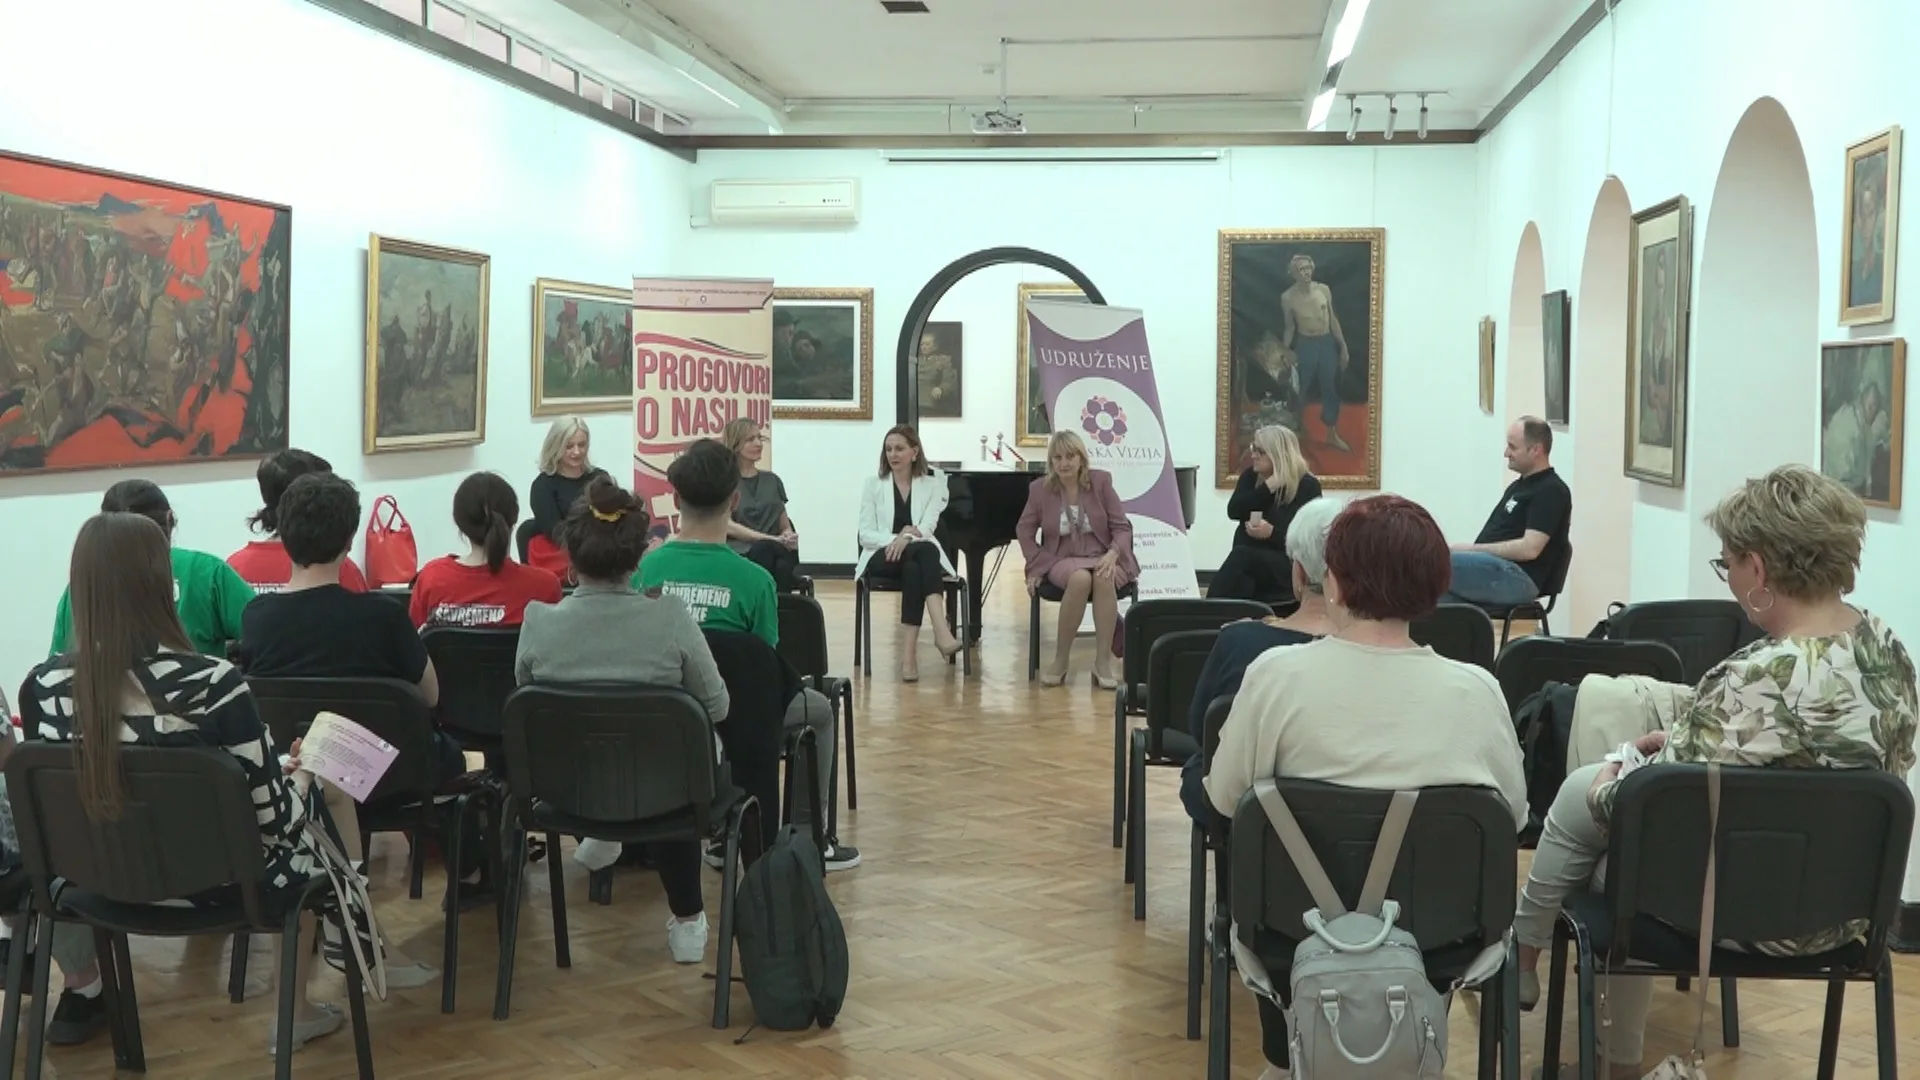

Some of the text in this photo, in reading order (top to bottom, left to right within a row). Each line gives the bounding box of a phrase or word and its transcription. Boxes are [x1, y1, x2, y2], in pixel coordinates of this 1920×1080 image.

[637, 347, 770, 395] PROGOVORI
[1040, 347, 1150, 373] UDRUŽENJE
[637, 397, 660, 440] O
[1087, 445, 1162, 460] SKA VIZIJA
[1140, 562, 1179, 570] mail.com
